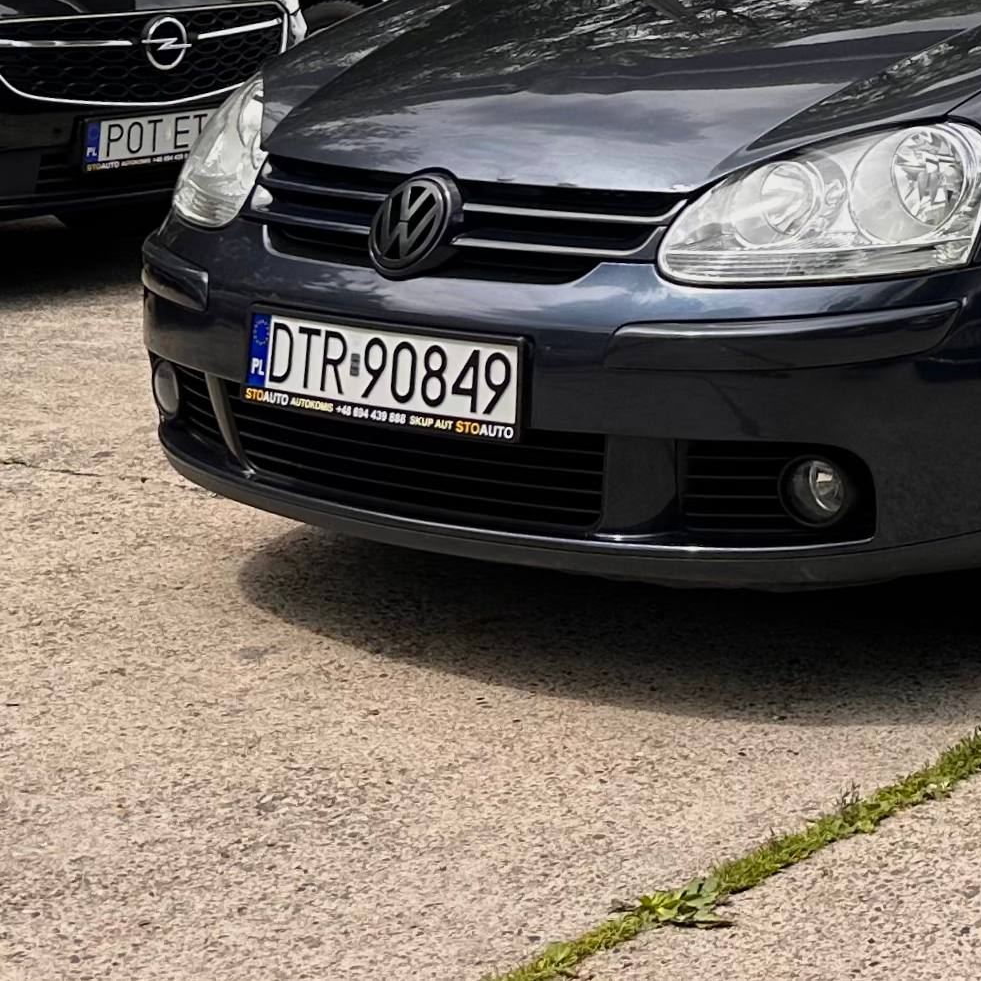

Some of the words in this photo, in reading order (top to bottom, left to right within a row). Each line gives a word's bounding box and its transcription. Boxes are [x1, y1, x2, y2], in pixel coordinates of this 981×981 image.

[86, 146, 98, 157] PL
[105, 119, 164, 158] POT
[251, 357, 265, 376] PL
[268, 322, 348, 395] DTR
[360, 337, 512, 415] 90849
[245, 387, 289, 406] STOAUTO
[290, 397, 334, 413] AUTOKOMIS
[409, 415, 434, 428] SKUP
[434, 419, 454, 430] AUT
[455, 420, 515, 439] STOAUTO
